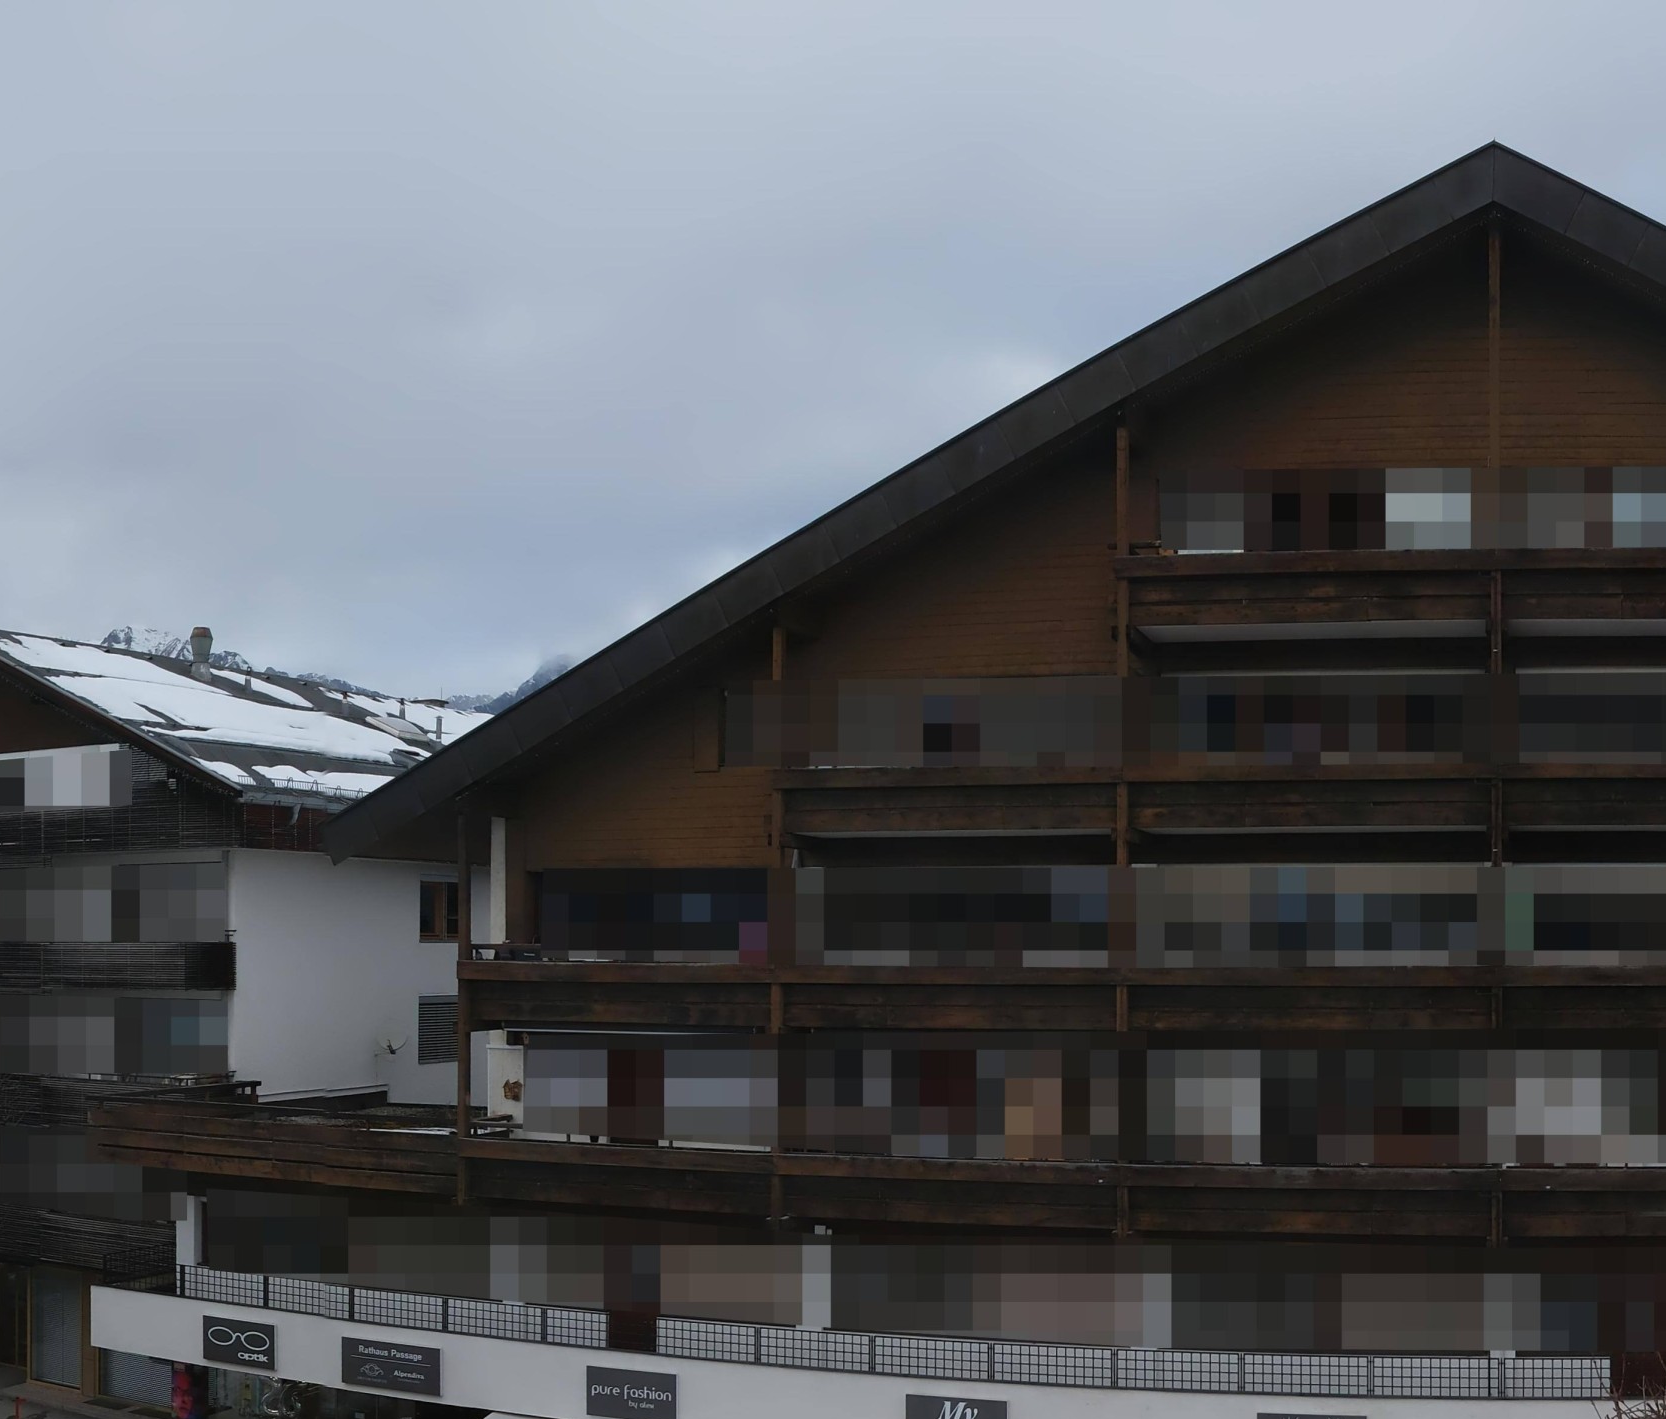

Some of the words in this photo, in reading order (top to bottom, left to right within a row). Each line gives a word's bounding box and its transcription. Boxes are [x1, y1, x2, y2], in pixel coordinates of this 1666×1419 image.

[237, 1351, 269, 1364] optik
[358, 1344, 389, 1357] Rathaus
[391, 1349, 422, 1362] Passage
[591, 1384, 621, 1396] pure
[623, 1384, 672, 1402] fashion
[628, 1400, 638, 1409] by
